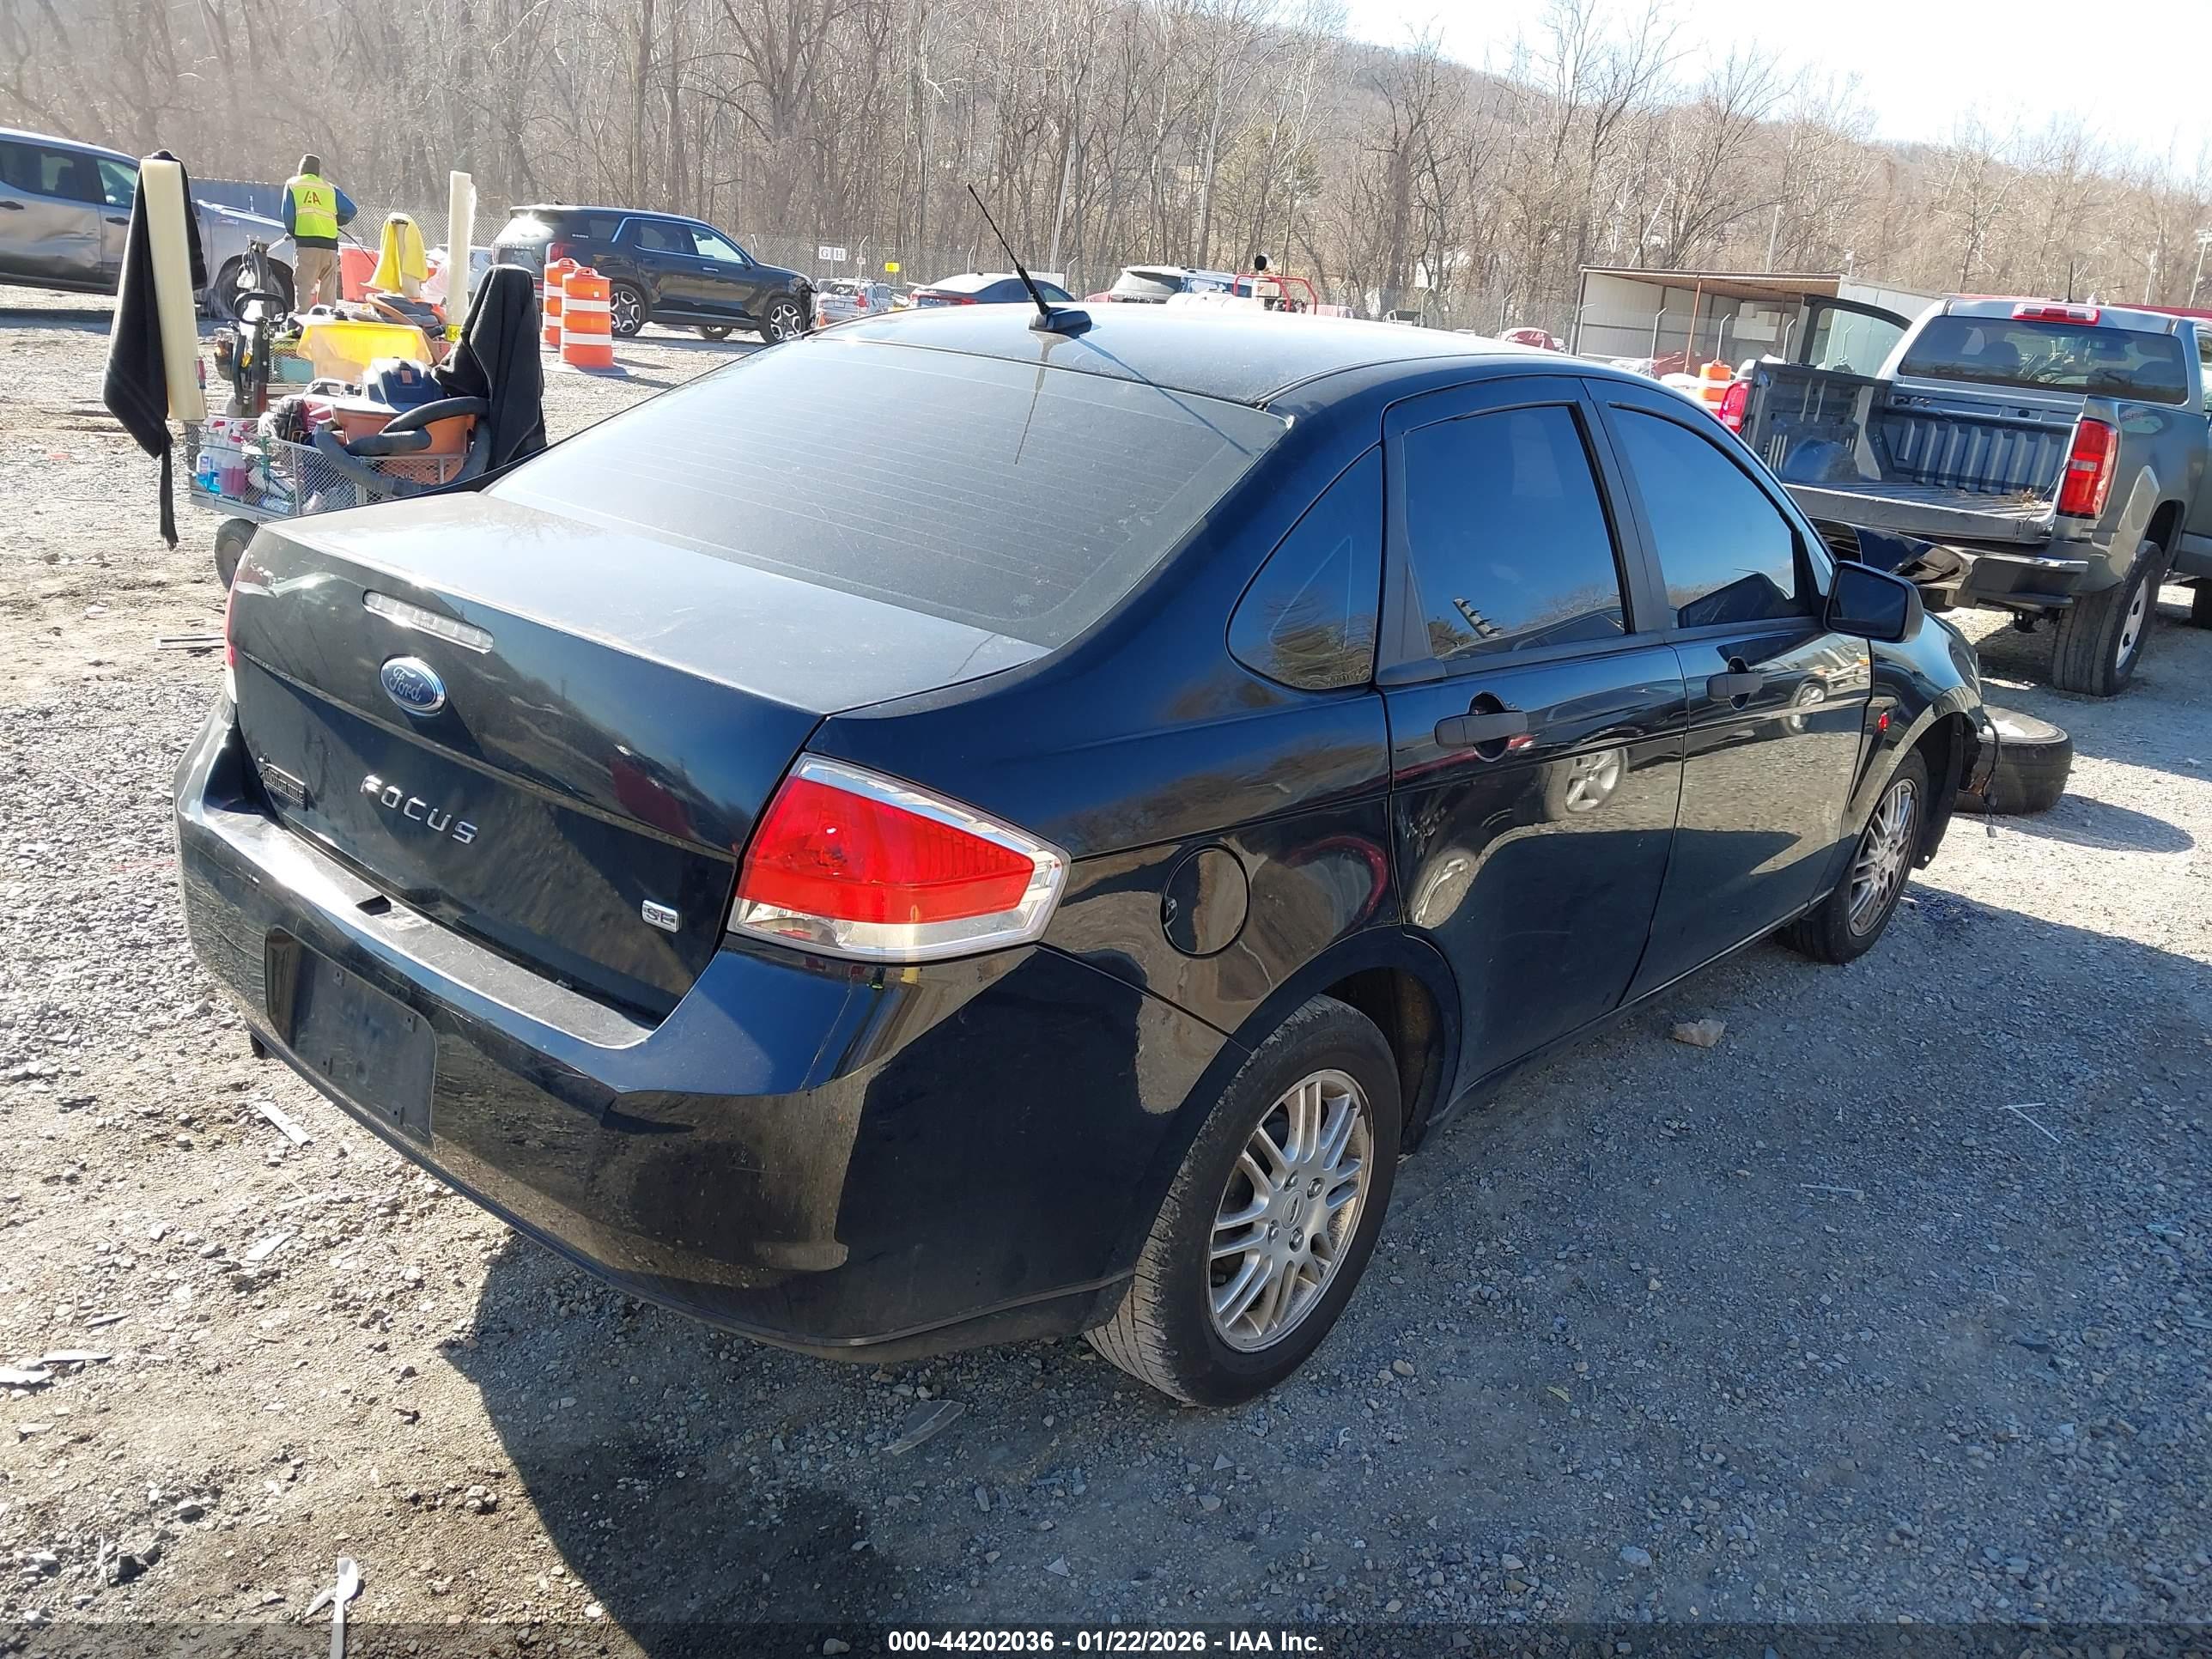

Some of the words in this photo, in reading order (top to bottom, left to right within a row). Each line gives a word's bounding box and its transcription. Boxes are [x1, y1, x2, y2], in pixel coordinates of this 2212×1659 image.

[821, 248, 830, 258] G
[836, 249, 845, 259] H
[389, 666, 421, 701] Ford
[360, 775, 478, 844] FOCUS
[645, 907, 676, 927] SE
